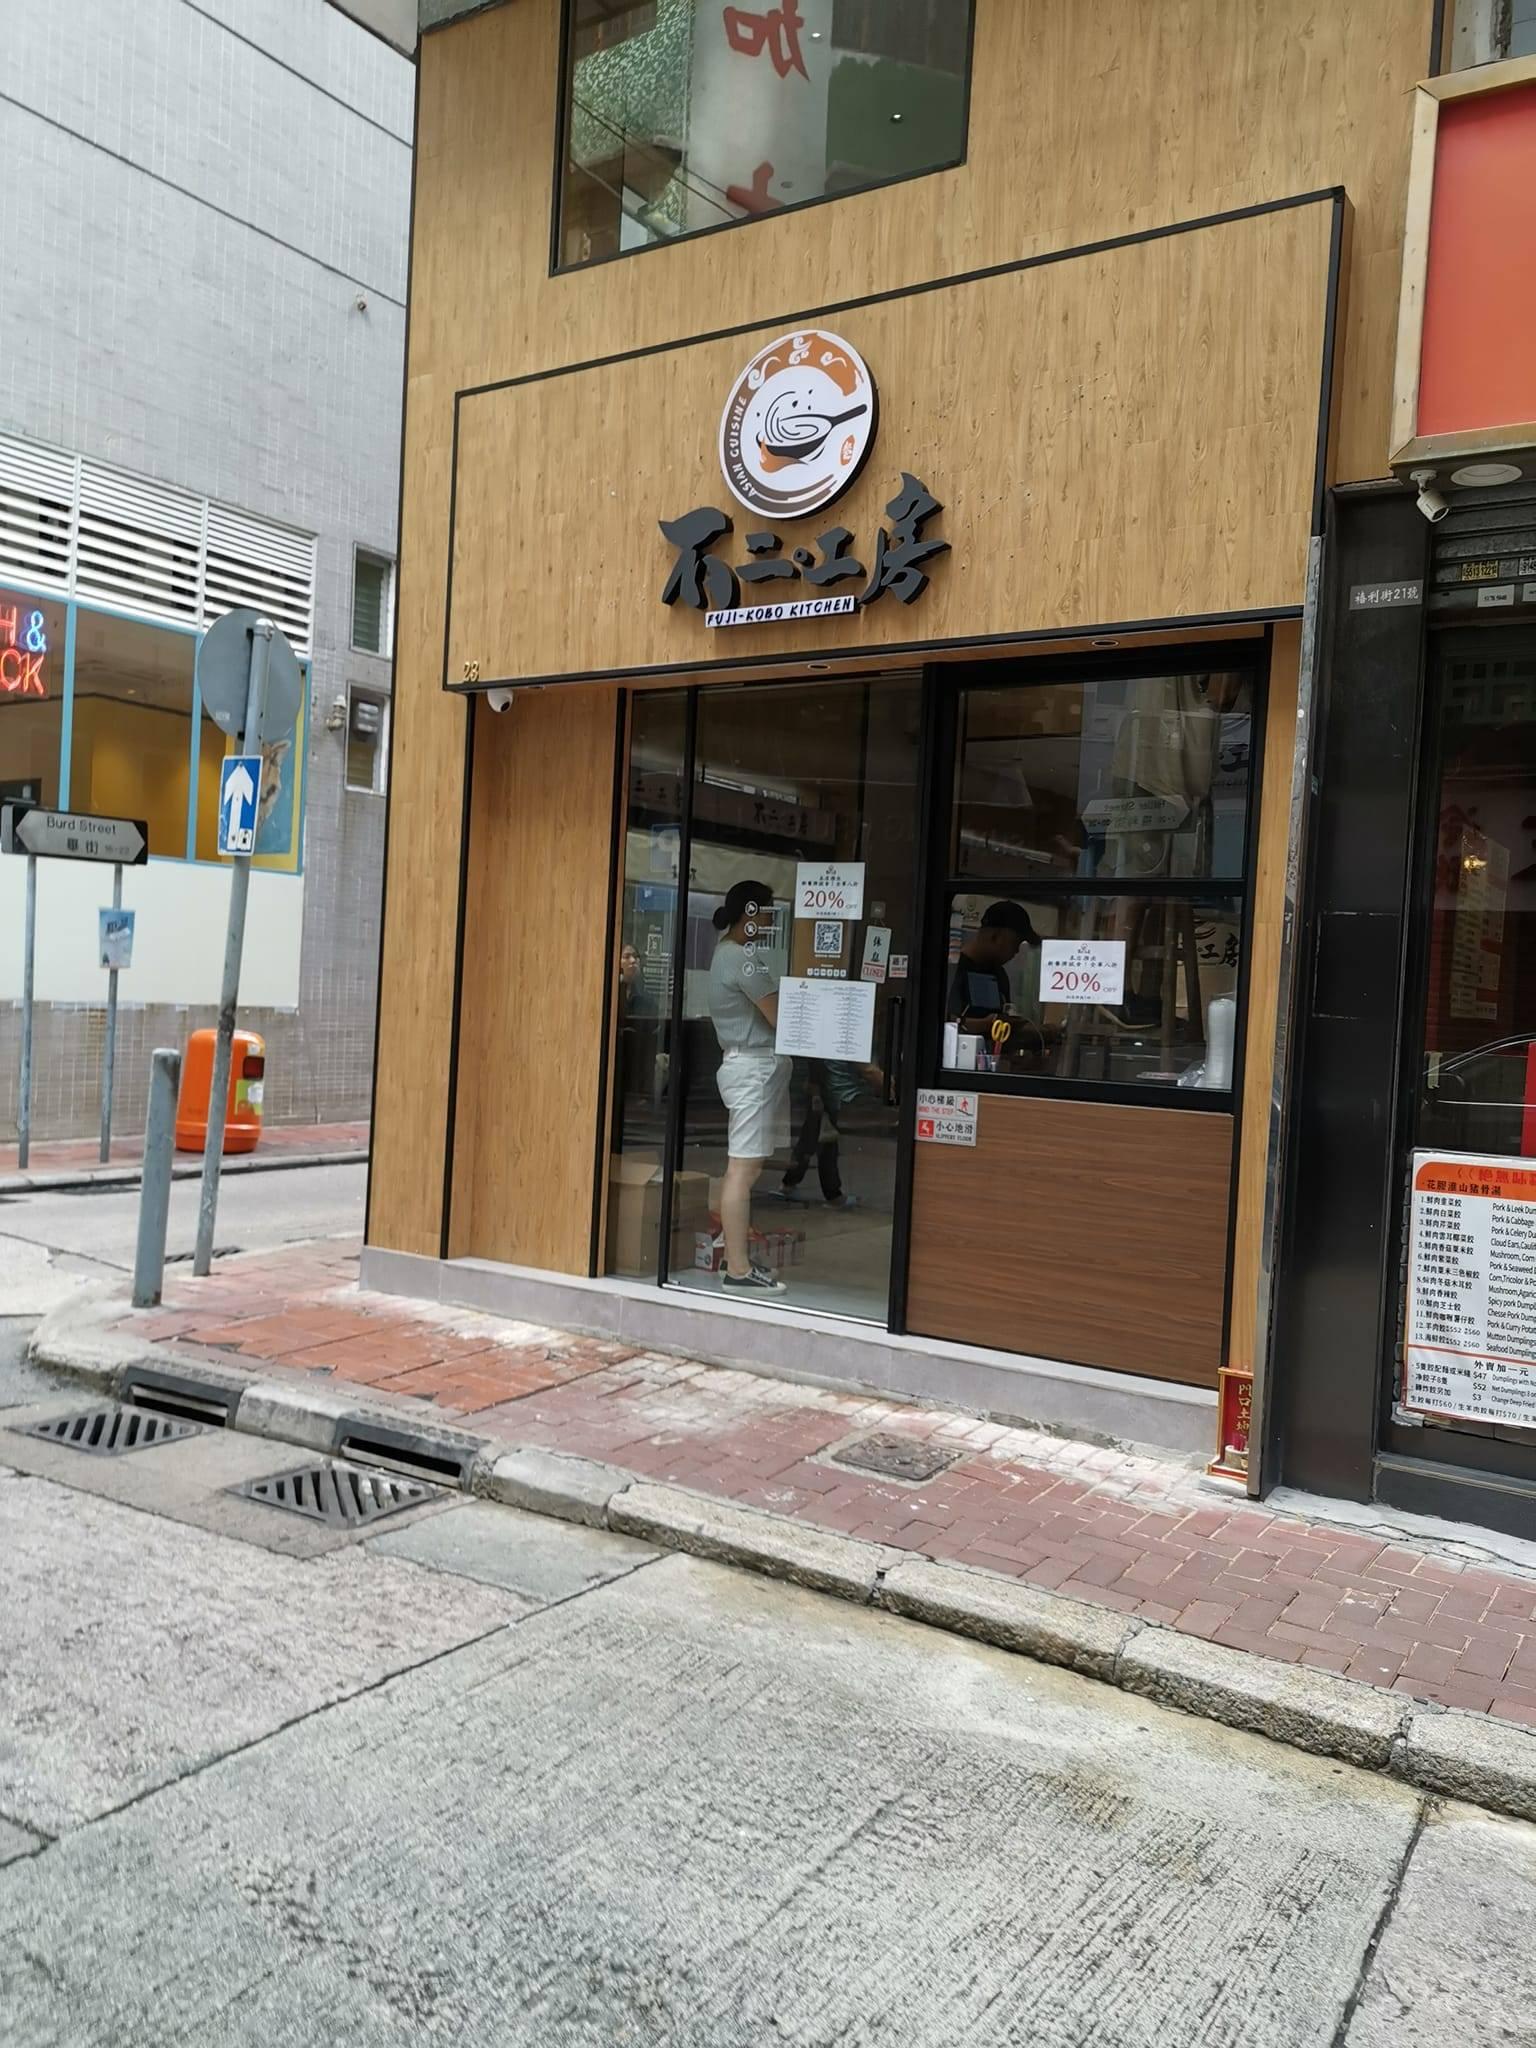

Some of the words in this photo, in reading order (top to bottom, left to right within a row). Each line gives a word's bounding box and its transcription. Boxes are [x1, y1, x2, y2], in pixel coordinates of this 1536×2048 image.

[729, 396, 747, 458] CUISINE
[732, 463, 756, 498] ASIAN
[708, 606, 783, 625] FUJI-KOBO
[790, 597, 852, 617] KITCHEN
[26, 610, 46, 652] &
[47, 815, 75, 830] Burd
[80, 819, 116, 835] Street
[804, 890, 844, 909] 20%
[1050, 971, 1100, 992] 20%
[920, 1094, 955, 1106] 小心梯級
[936, 1121, 973, 1134] 小心地滑
[1493, 1203, 1505, 1211] Pork
[1506, 1204, 1510, 1212] &
[1512, 1205, 1524, 1213] Leek
[1492, 1214, 1504, 1223] Pork
[1506, 1216, 1510, 1224] &
[1511, 1216, 1534, 1228] Cabbage
[1491, 1226, 1504, 1235] Pork
[1505, 1228, 1509, 1236] &
[1510, 1228, 1527, 1239] Celery
[1491, 1238, 1507, 1247] Cloud
[1490, 1261, 1502, 1270] Pork
[1508, 1263, 1533, 1274] Seaweed
[1488, 1296, 1503, 1308] Spicy
[1503, 1300, 1515, 1308] pork
[1507, 1311, 1520, 1319] Pork
[1487, 1319, 1500, 1328] Pork
[1506, 1322, 1521, 1334] Curry
[1487, 1332, 1506, 1341] Mutton
[1486, 1343, 1508, 1353] Seafood
[1474, 1360, 1529, 1377] 外賣加一元
[1472, 1393, 1482, 1401] $3
